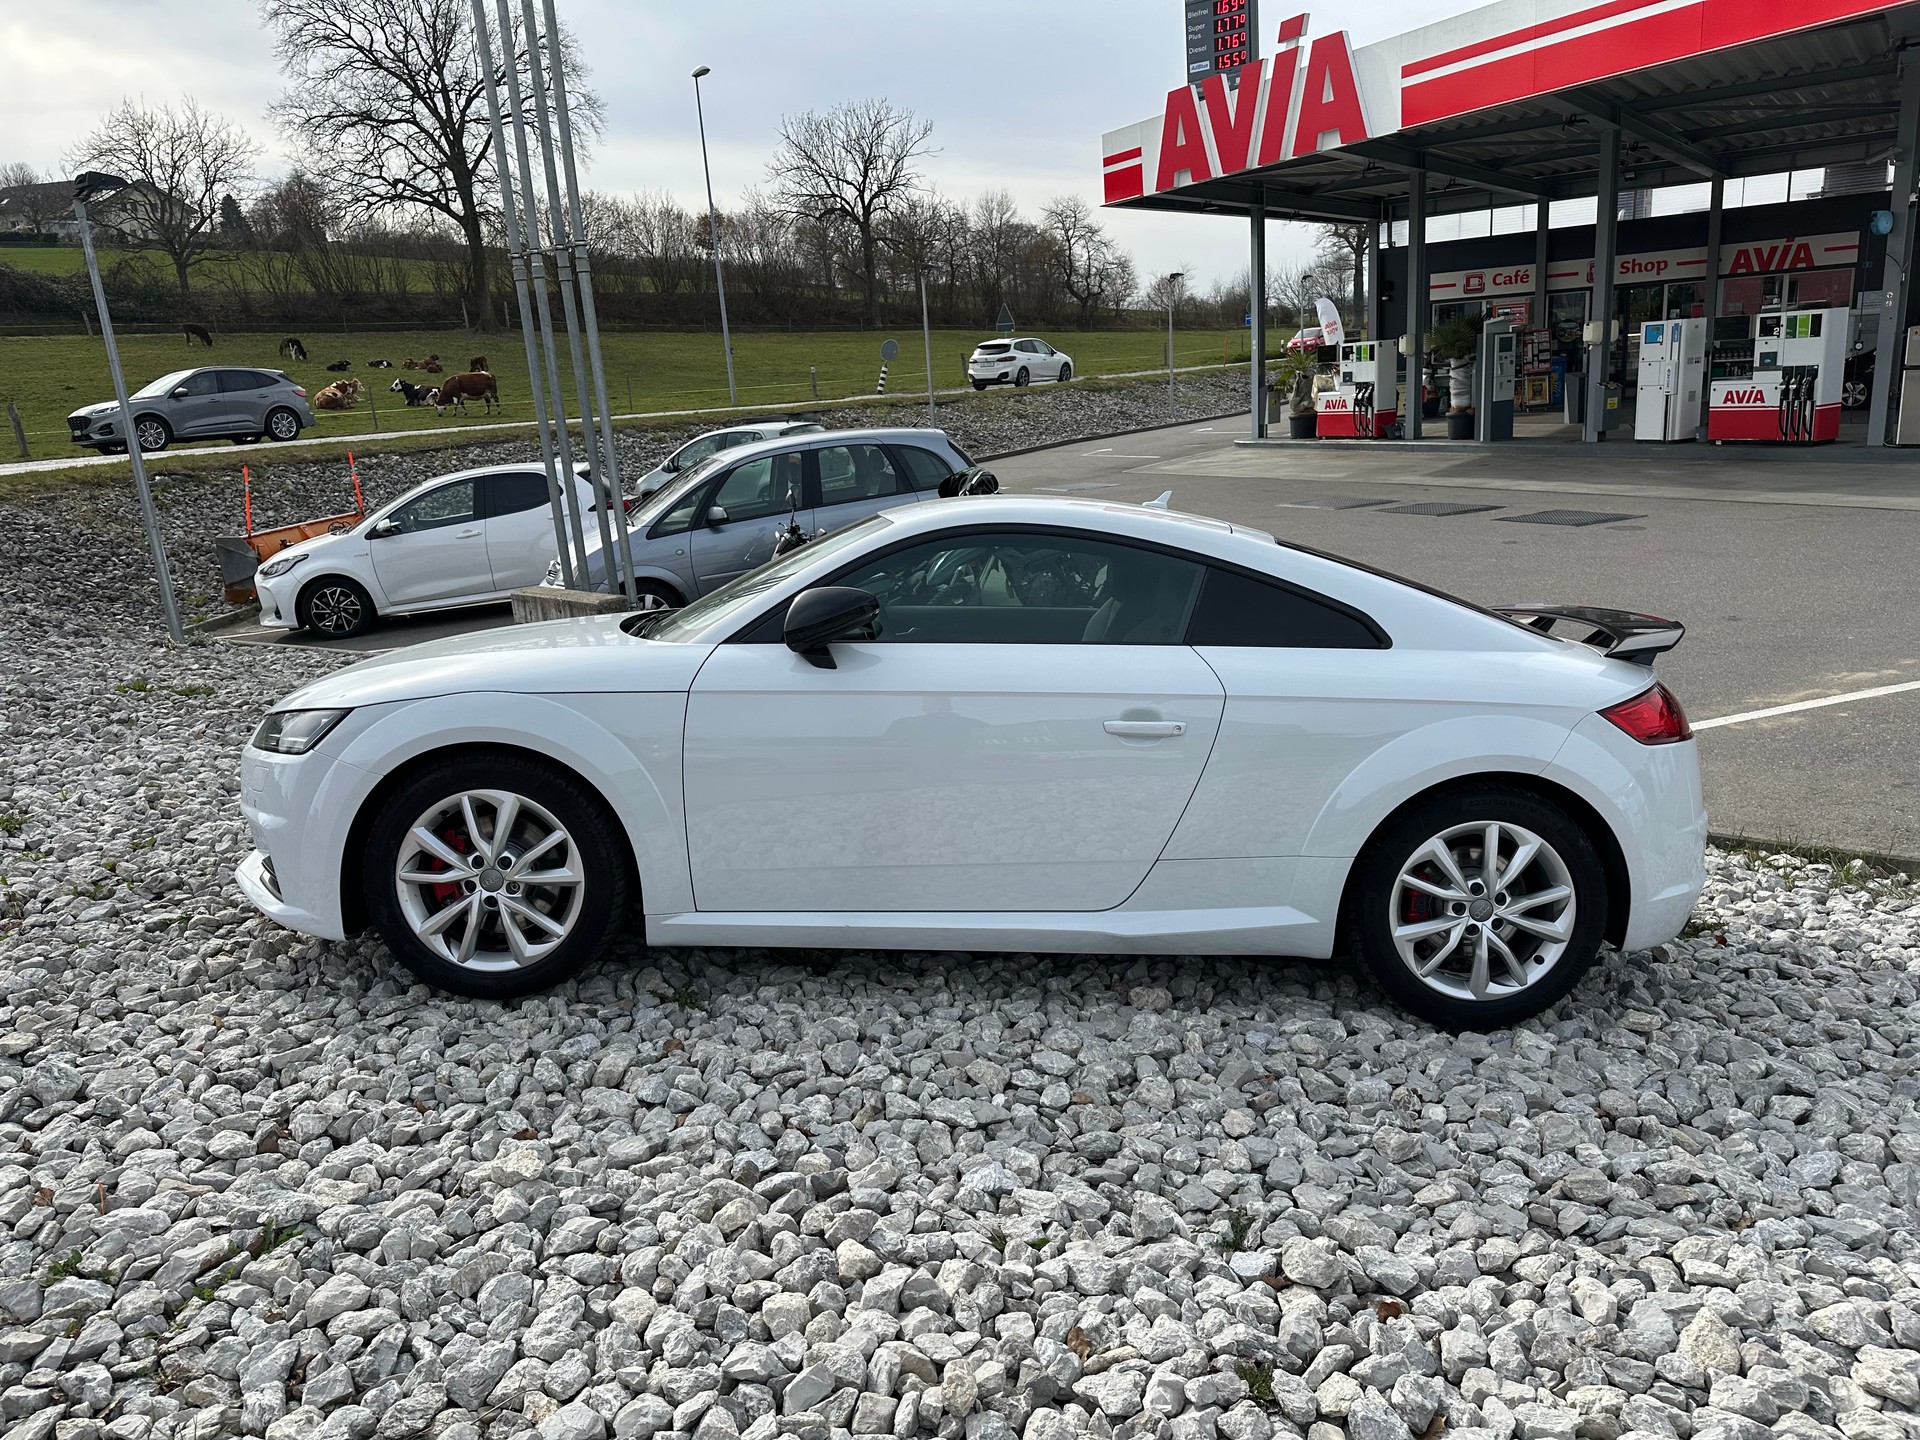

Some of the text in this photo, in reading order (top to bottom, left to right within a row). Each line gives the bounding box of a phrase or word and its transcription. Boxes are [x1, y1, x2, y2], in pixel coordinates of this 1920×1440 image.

[1187, 9, 1209, 19] Bleifrei
[1188, 24, 1206, 33] Super
[1188, 45, 1207, 55] Diesel
[1619, 258, 1668, 276] Shop
[1491, 269, 1530, 287] Café
[1773, 327, 1780, 335] 2
